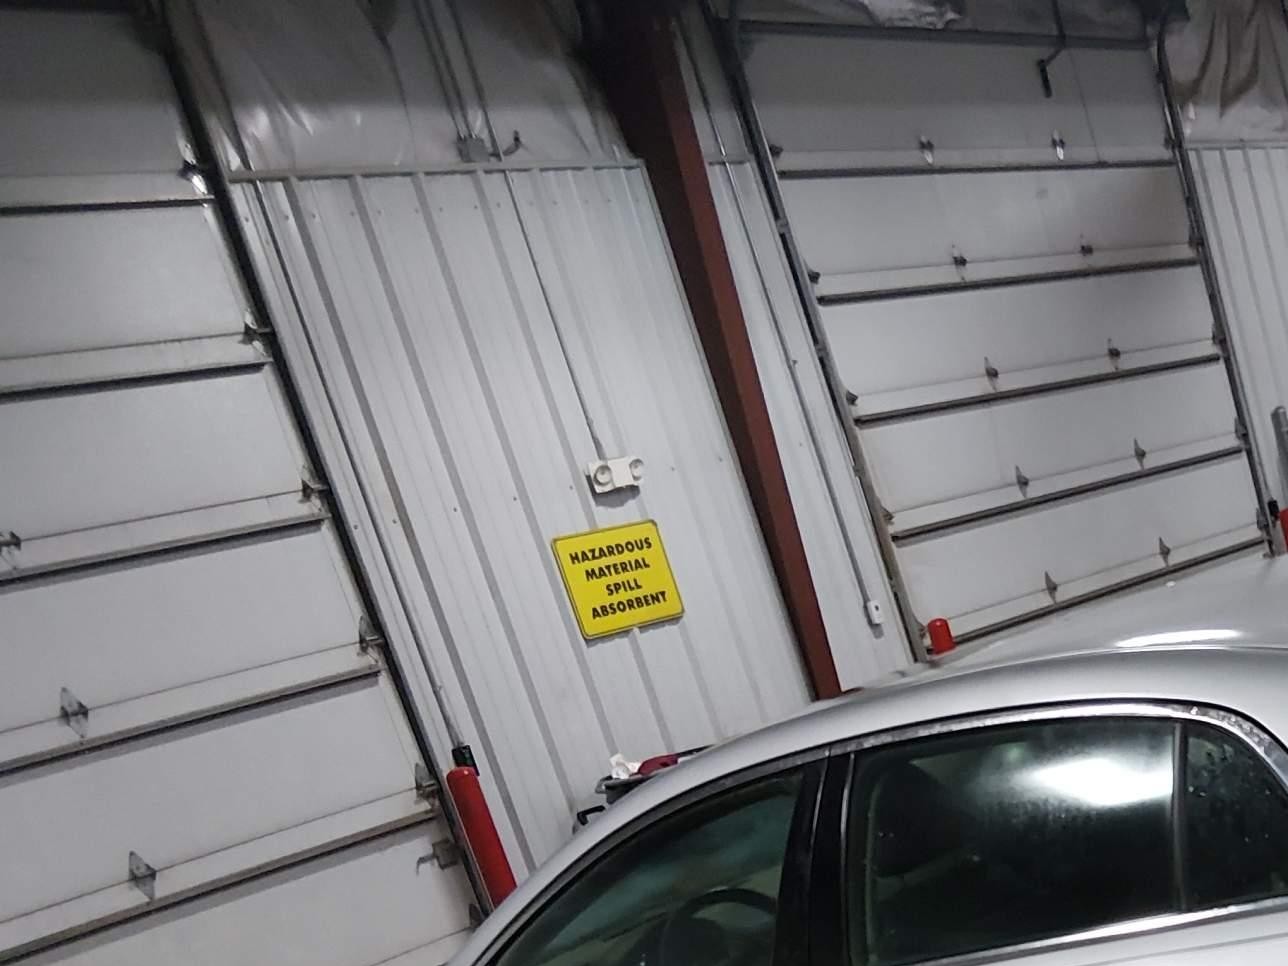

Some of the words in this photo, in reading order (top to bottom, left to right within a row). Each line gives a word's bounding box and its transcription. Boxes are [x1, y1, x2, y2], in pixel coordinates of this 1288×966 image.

[568, 537, 652, 565] HAZARDOUS
[584, 557, 650, 582] MATERIAL
[605, 578, 643, 596] SPILL
[591, 590, 667, 620] ABSORBENT
